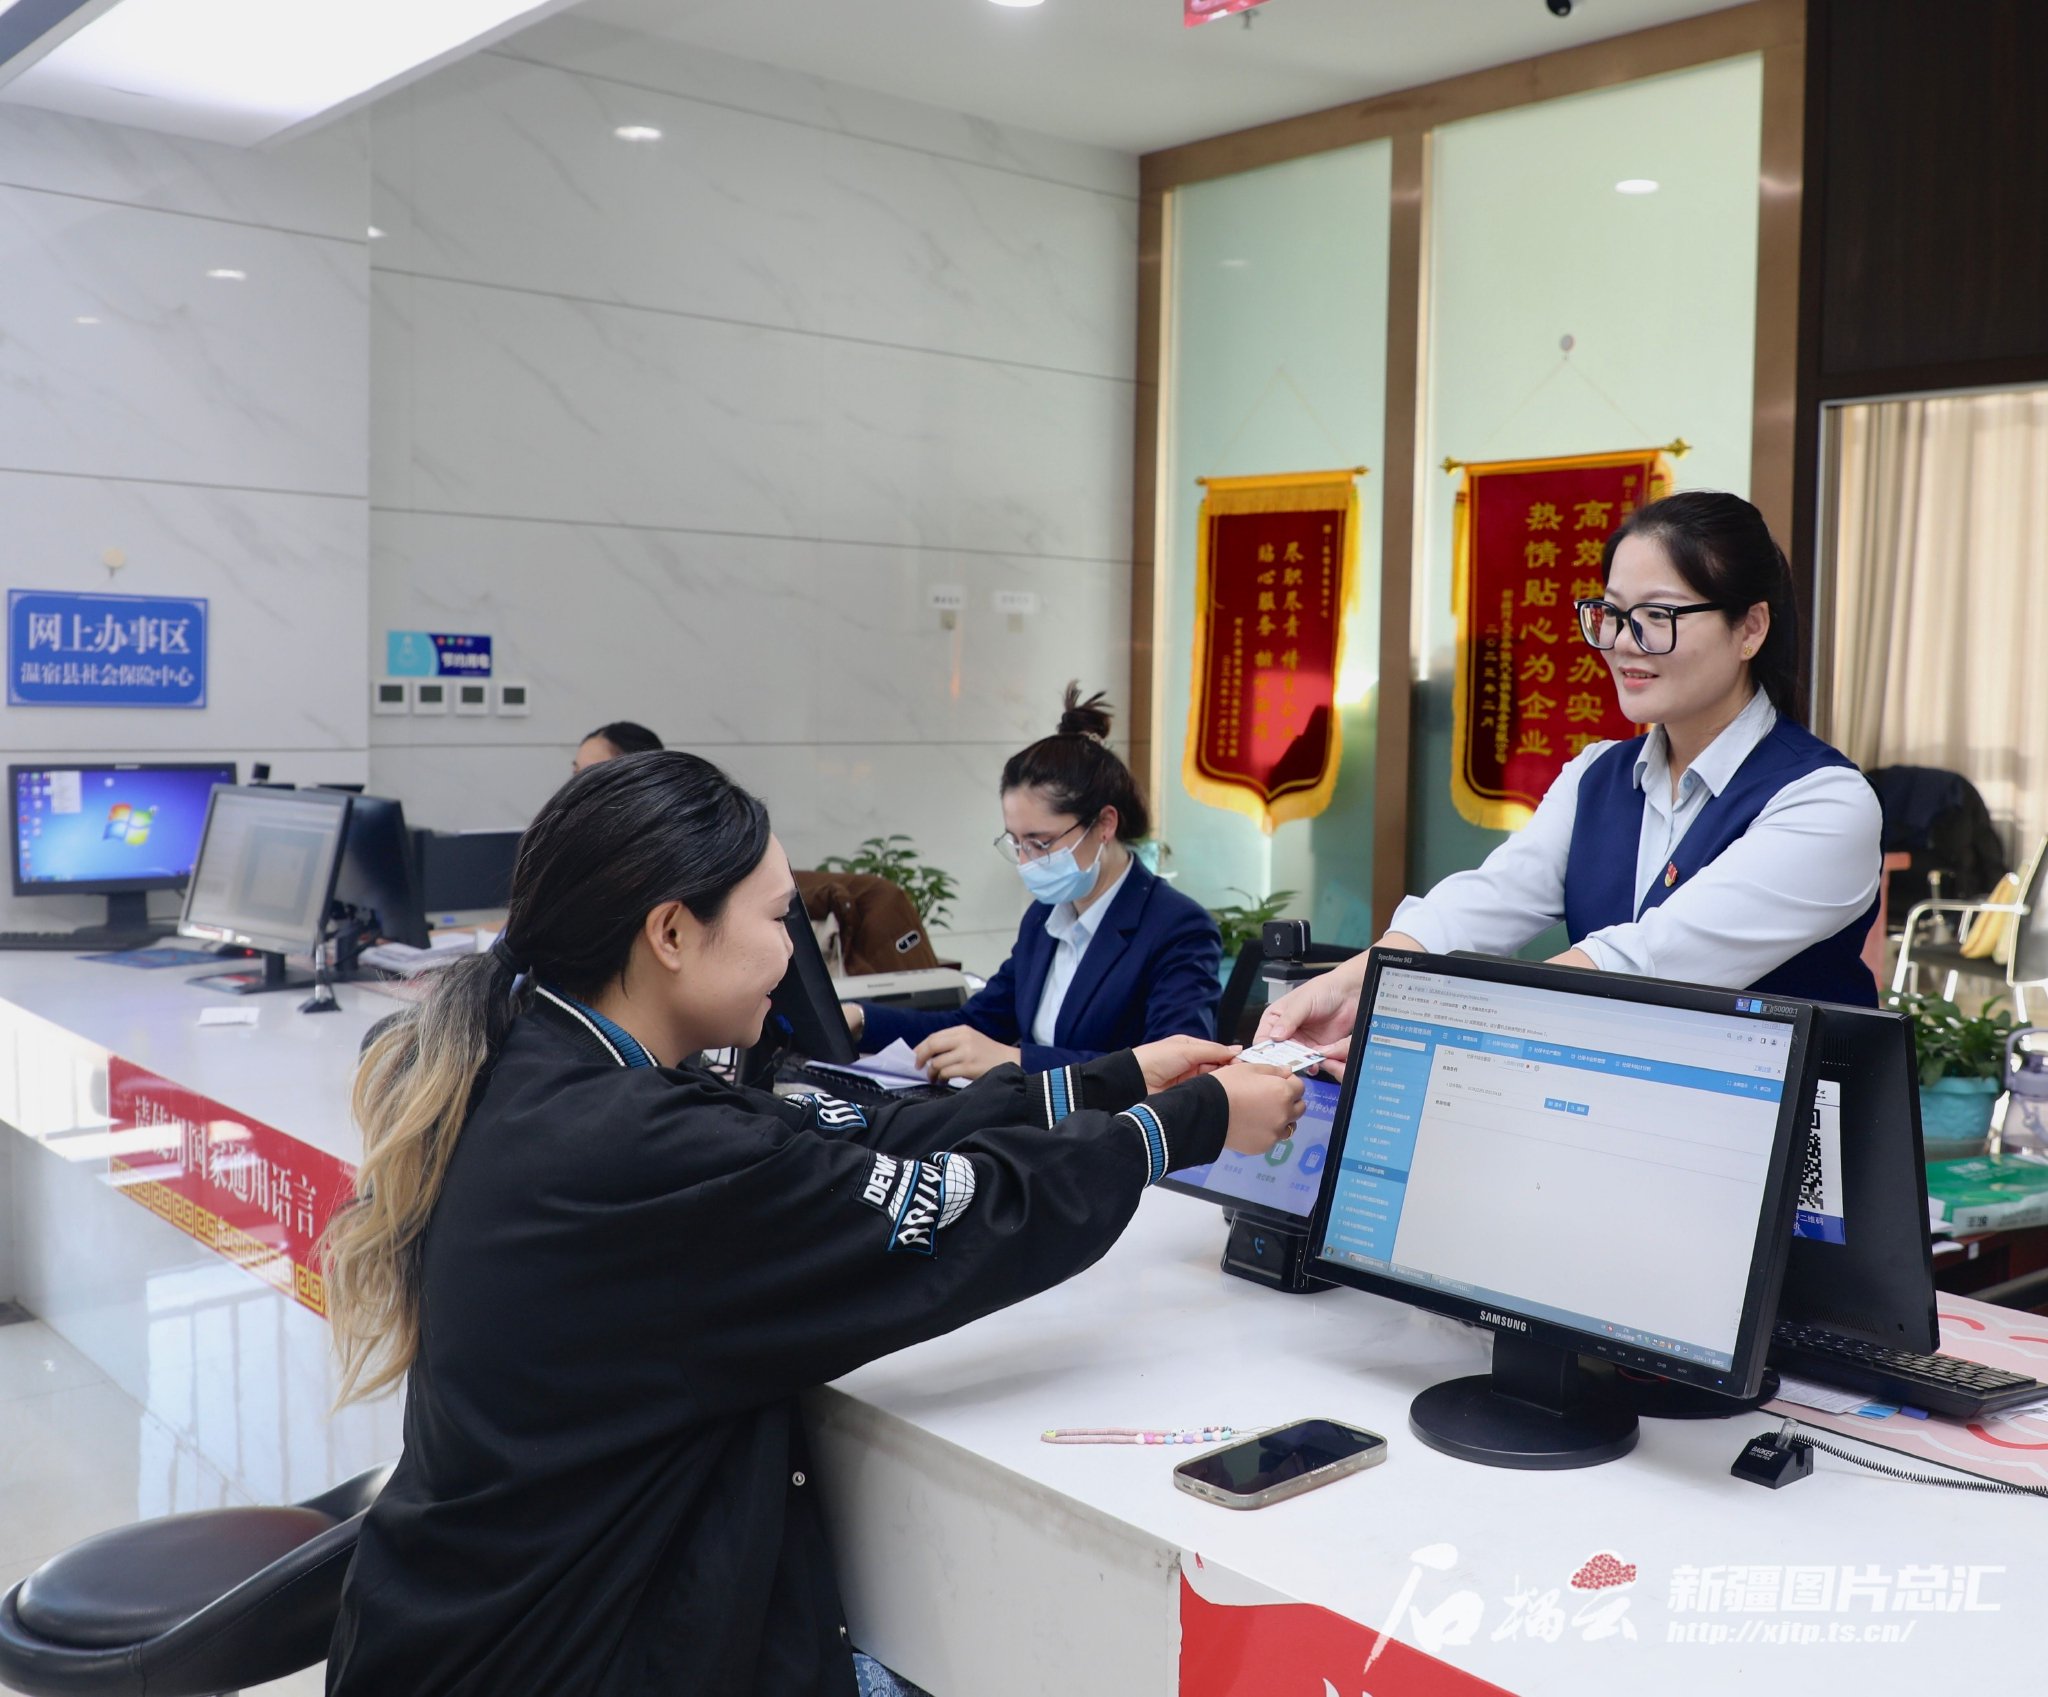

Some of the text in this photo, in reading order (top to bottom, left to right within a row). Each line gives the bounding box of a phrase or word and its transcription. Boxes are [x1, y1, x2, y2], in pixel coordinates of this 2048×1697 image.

[28, 612, 191, 655] 网上办事区
[1515, 502, 1564, 766] 热情贴心为企业
[20, 661, 196, 688] 温宿县社会保险中心
[1377, 953, 1403, 963] SyncMaster
[1479, 1310, 1527, 1332] SAMSUNG
